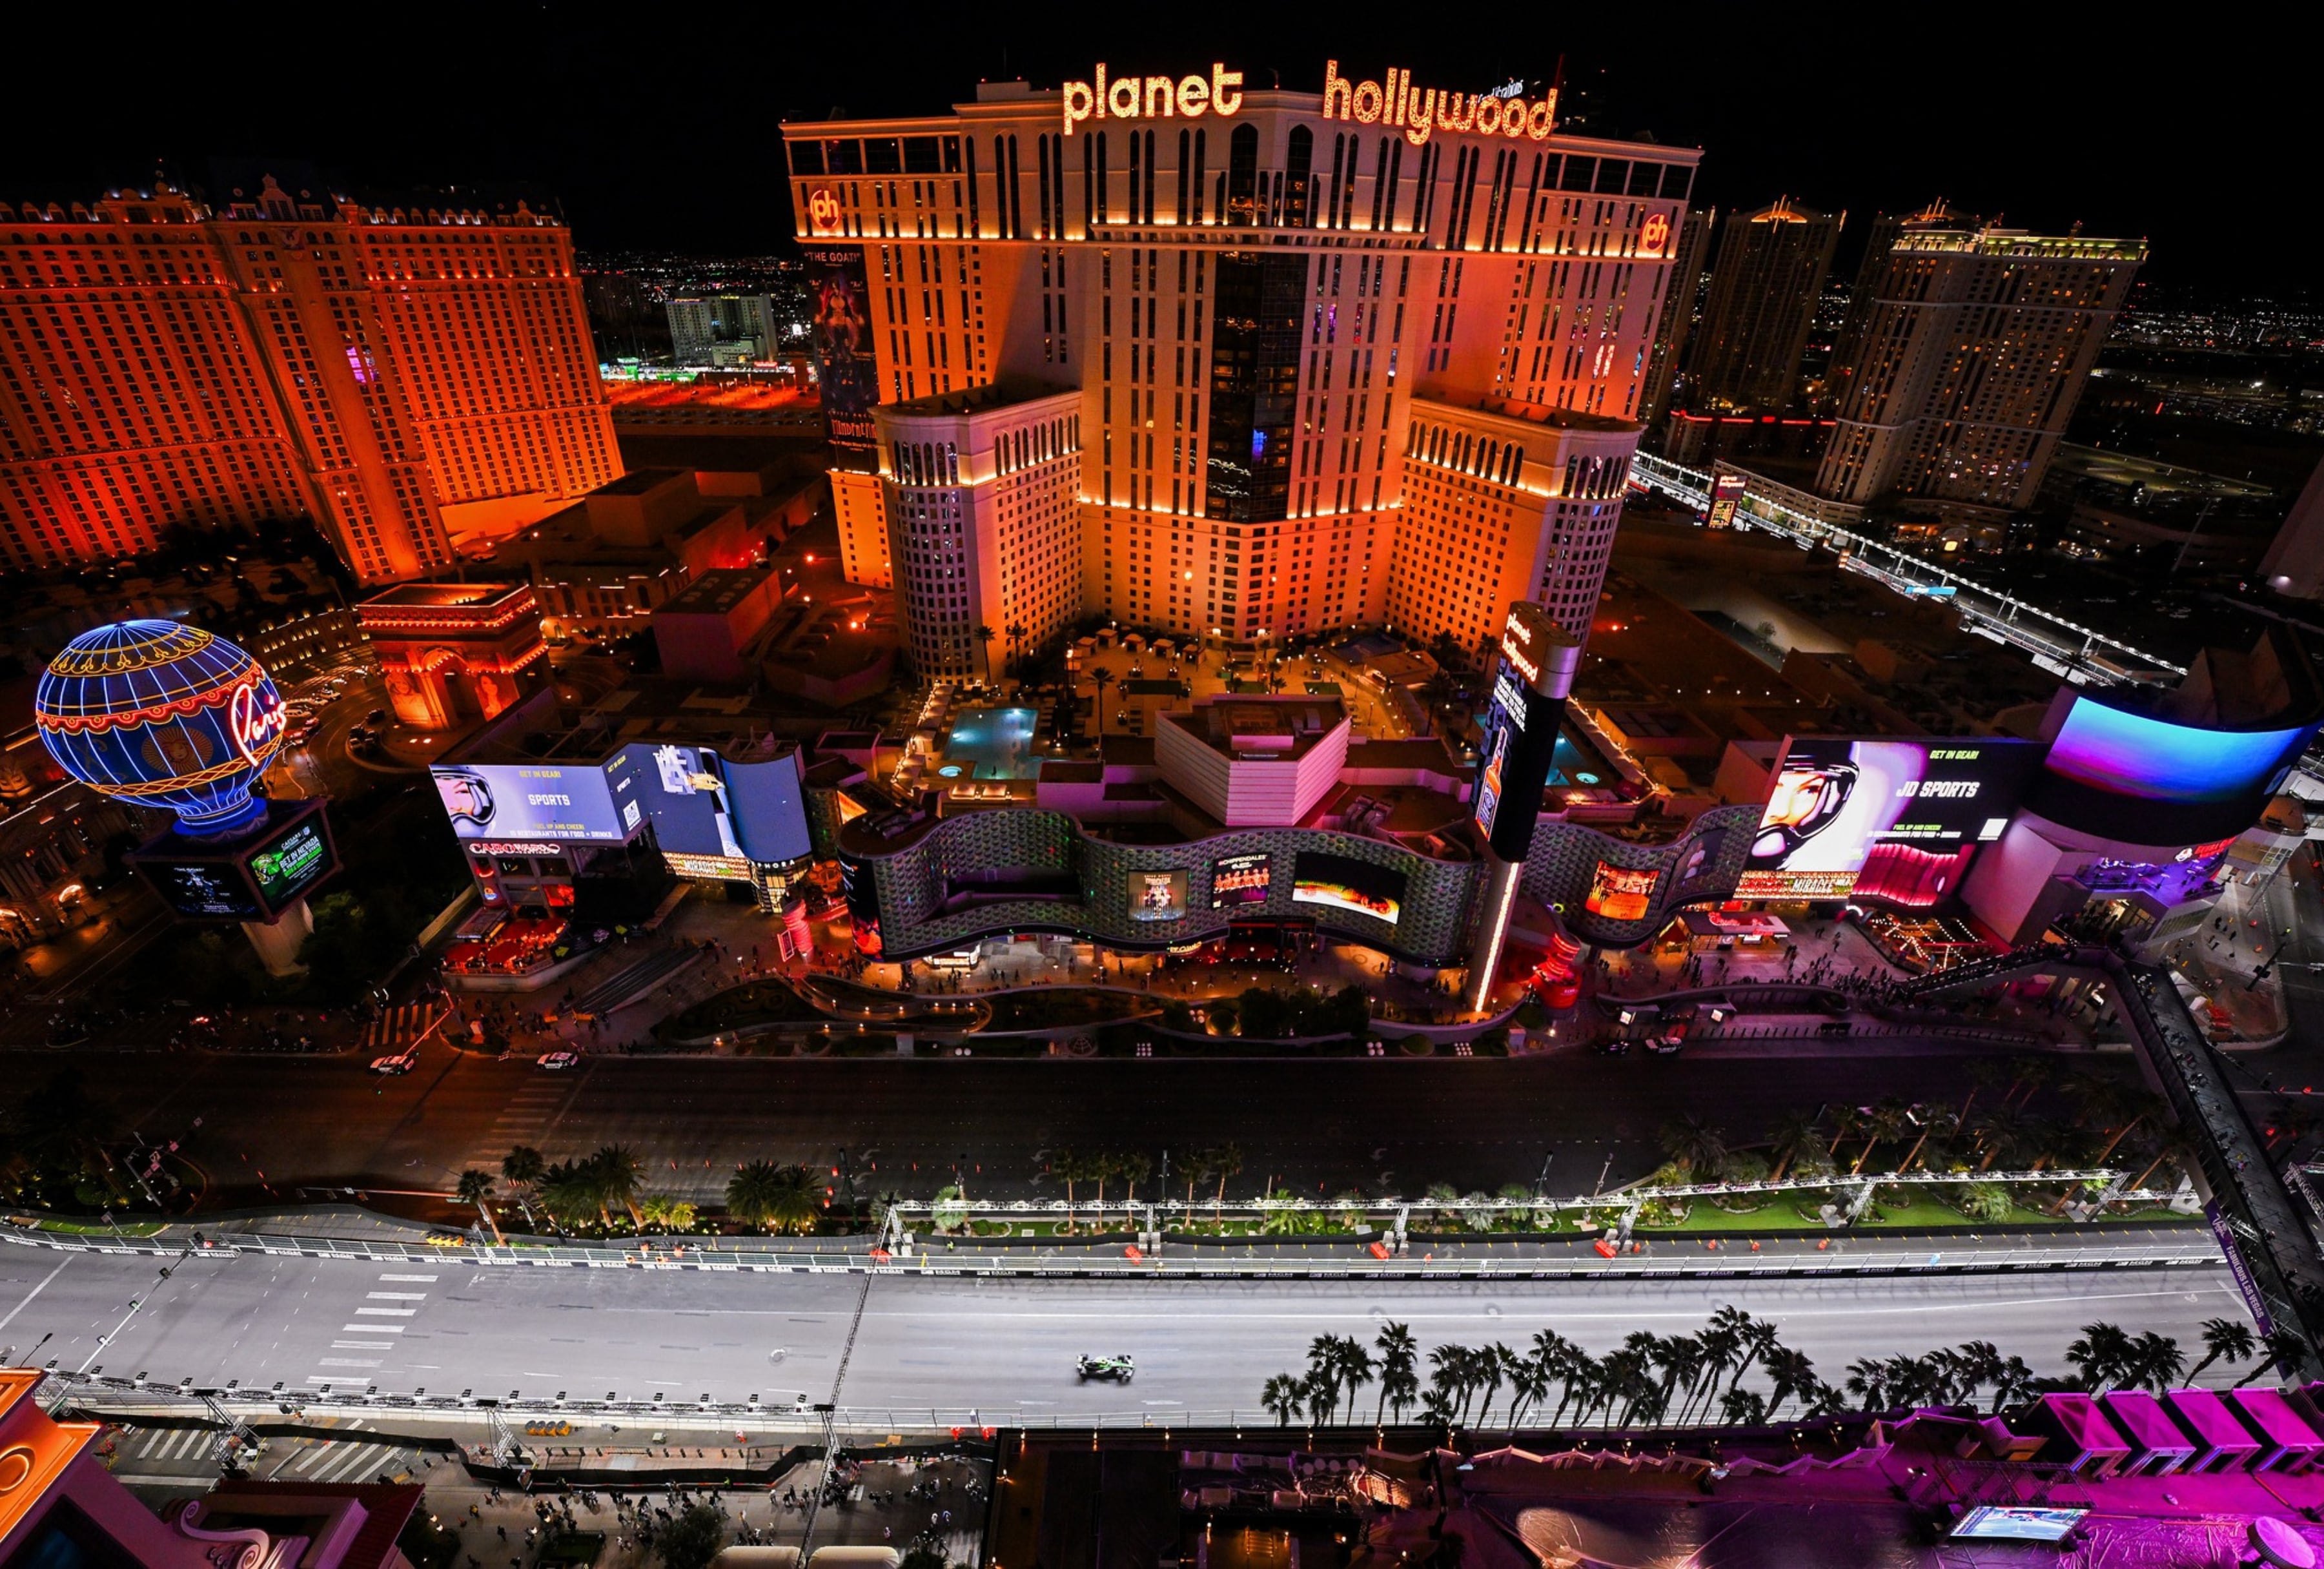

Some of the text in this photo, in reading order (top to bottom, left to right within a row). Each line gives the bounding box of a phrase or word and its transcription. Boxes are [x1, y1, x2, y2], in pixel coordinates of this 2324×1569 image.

[1062, 59, 1558, 145] planet hollywood
[813, 190, 839, 223] ph
[1644, 214, 1669, 245] ph
[1506, 613, 1531, 645] planet
[1502, 632, 1538, 682] hollywood
[230, 683, 287, 766] Paris
[1930, 750, 1980, 759] GET IN GEAR!
[528, 794, 571, 806] SPORTS
[1896, 781, 1981, 798] JD SPORTS
[1793, 878, 1833, 893] MIRACLE
[2225, 1245, 2265, 1318] FABULOUS LAS VEGAS
